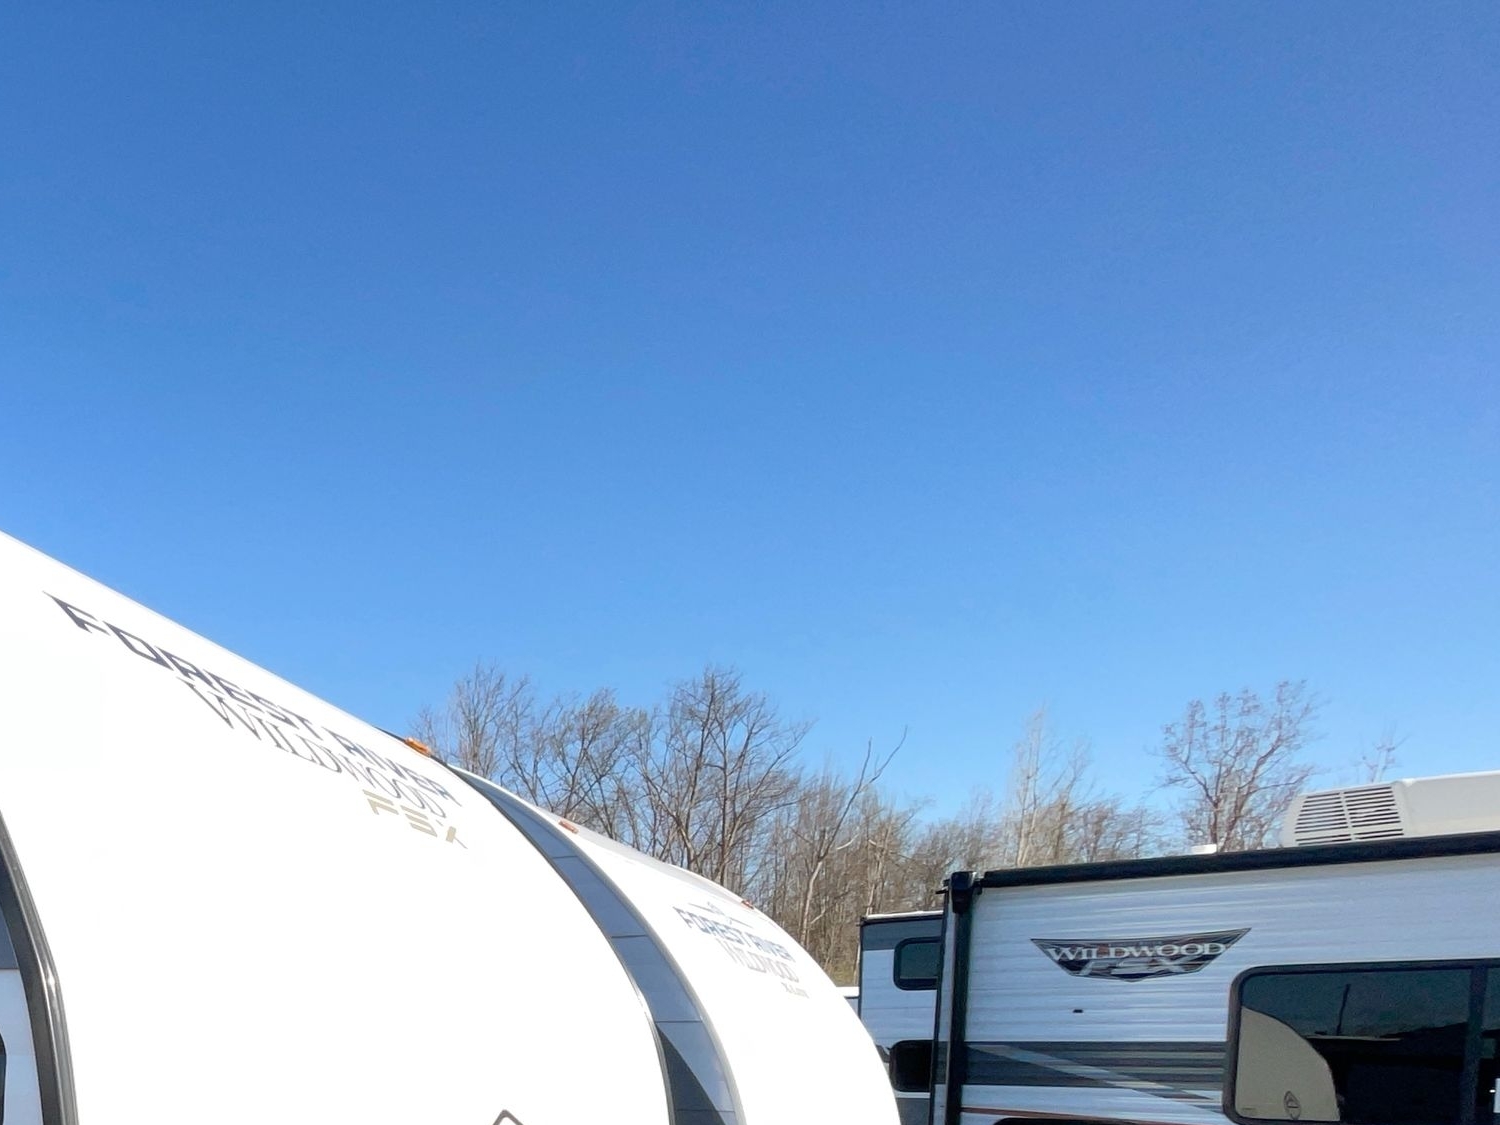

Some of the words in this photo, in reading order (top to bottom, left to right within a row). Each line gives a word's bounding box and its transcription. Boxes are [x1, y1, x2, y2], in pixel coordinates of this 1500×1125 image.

[42, 590, 323, 741] FOREST
[321, 726, 463, 807] RIVER
[176, 676, 447, 818] WILDWOOD
[1046, 942, 1227, 961] WILDWOOD
